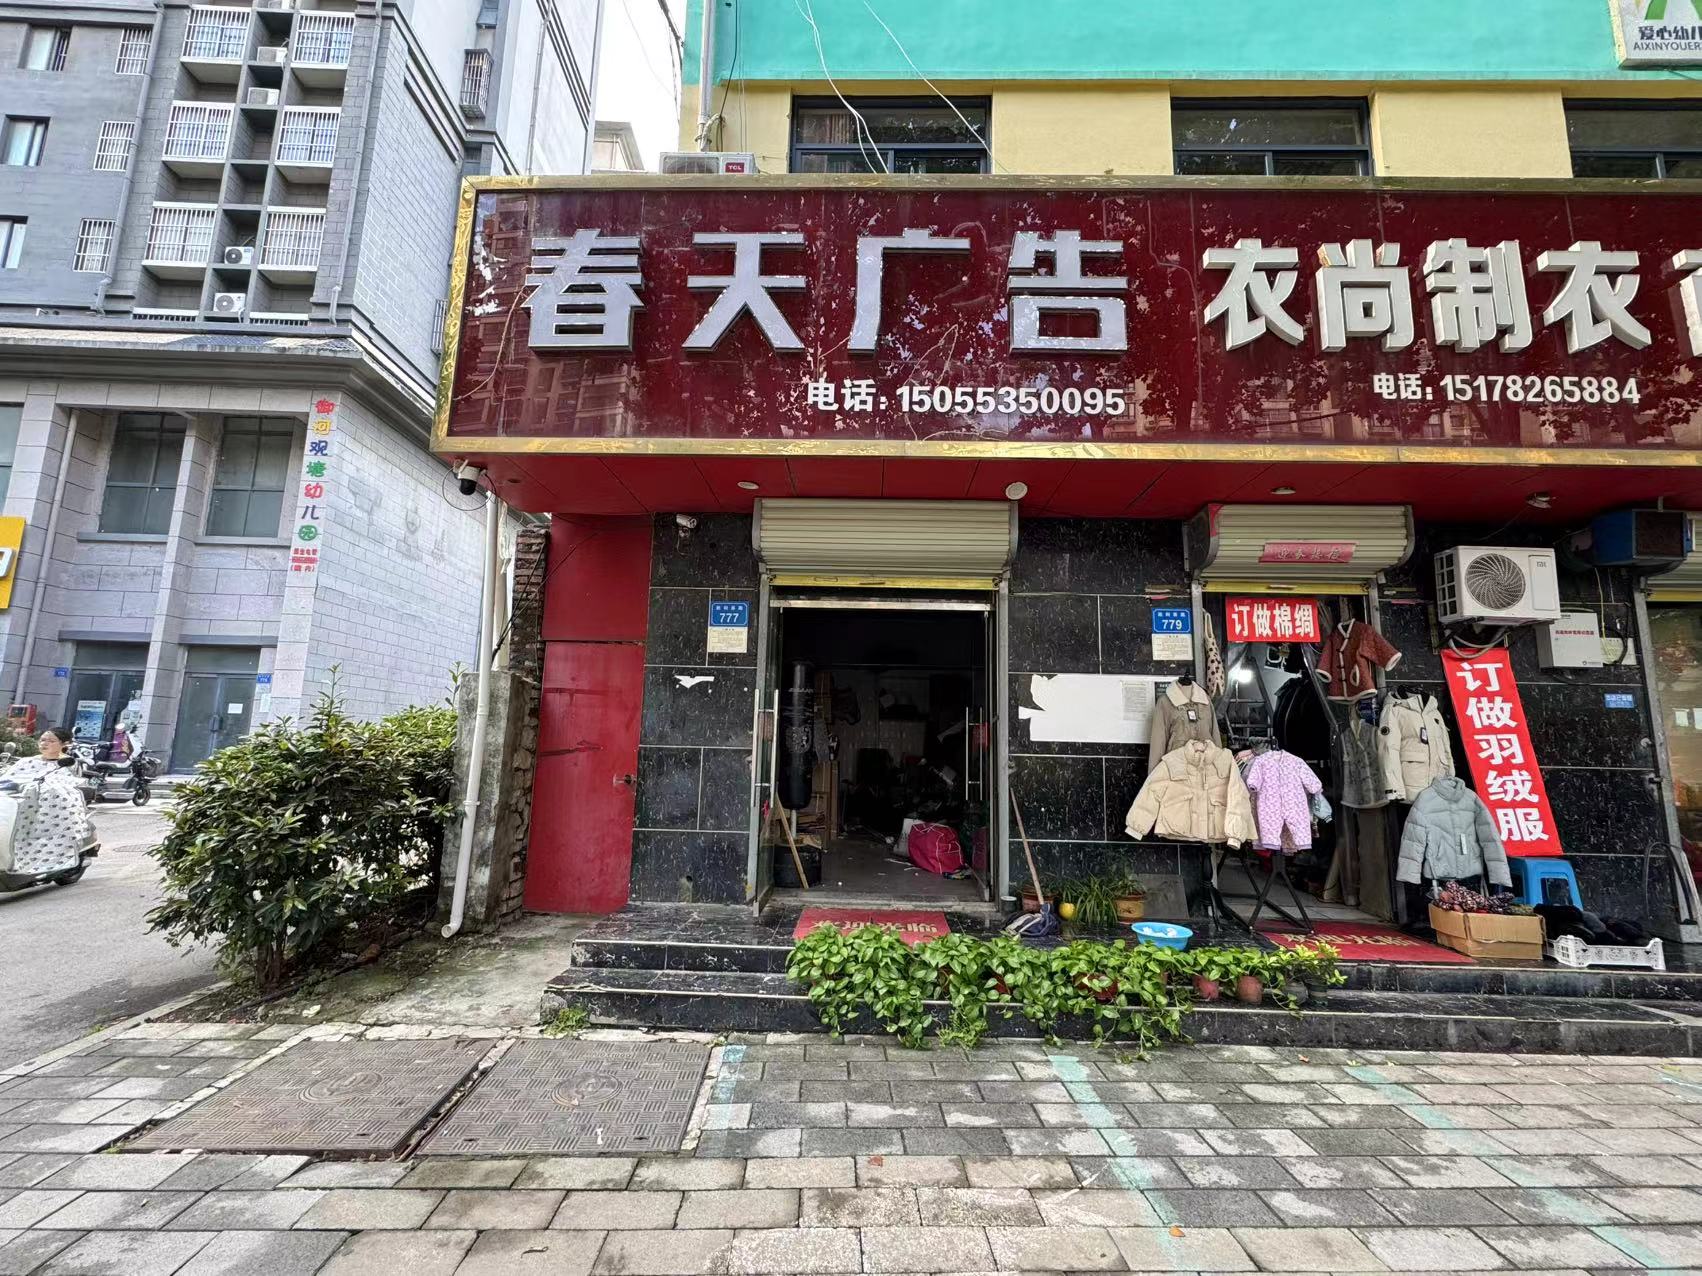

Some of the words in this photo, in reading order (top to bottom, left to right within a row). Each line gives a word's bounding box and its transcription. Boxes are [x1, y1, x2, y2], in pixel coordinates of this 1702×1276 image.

[520, 227, 1128, 354] 春天广告
[1203, 238, 1702, 357] 衣尚制衣
[298, 398, 335, 542] 御河观塘幼儿园
[719, 612, 739, 623] 777
[1162, 619, 1183, 630] 779
[1231, 603, 1315, 638] 订做棉绸
[1456, 661, 1550, 843] 订做羽绒服
